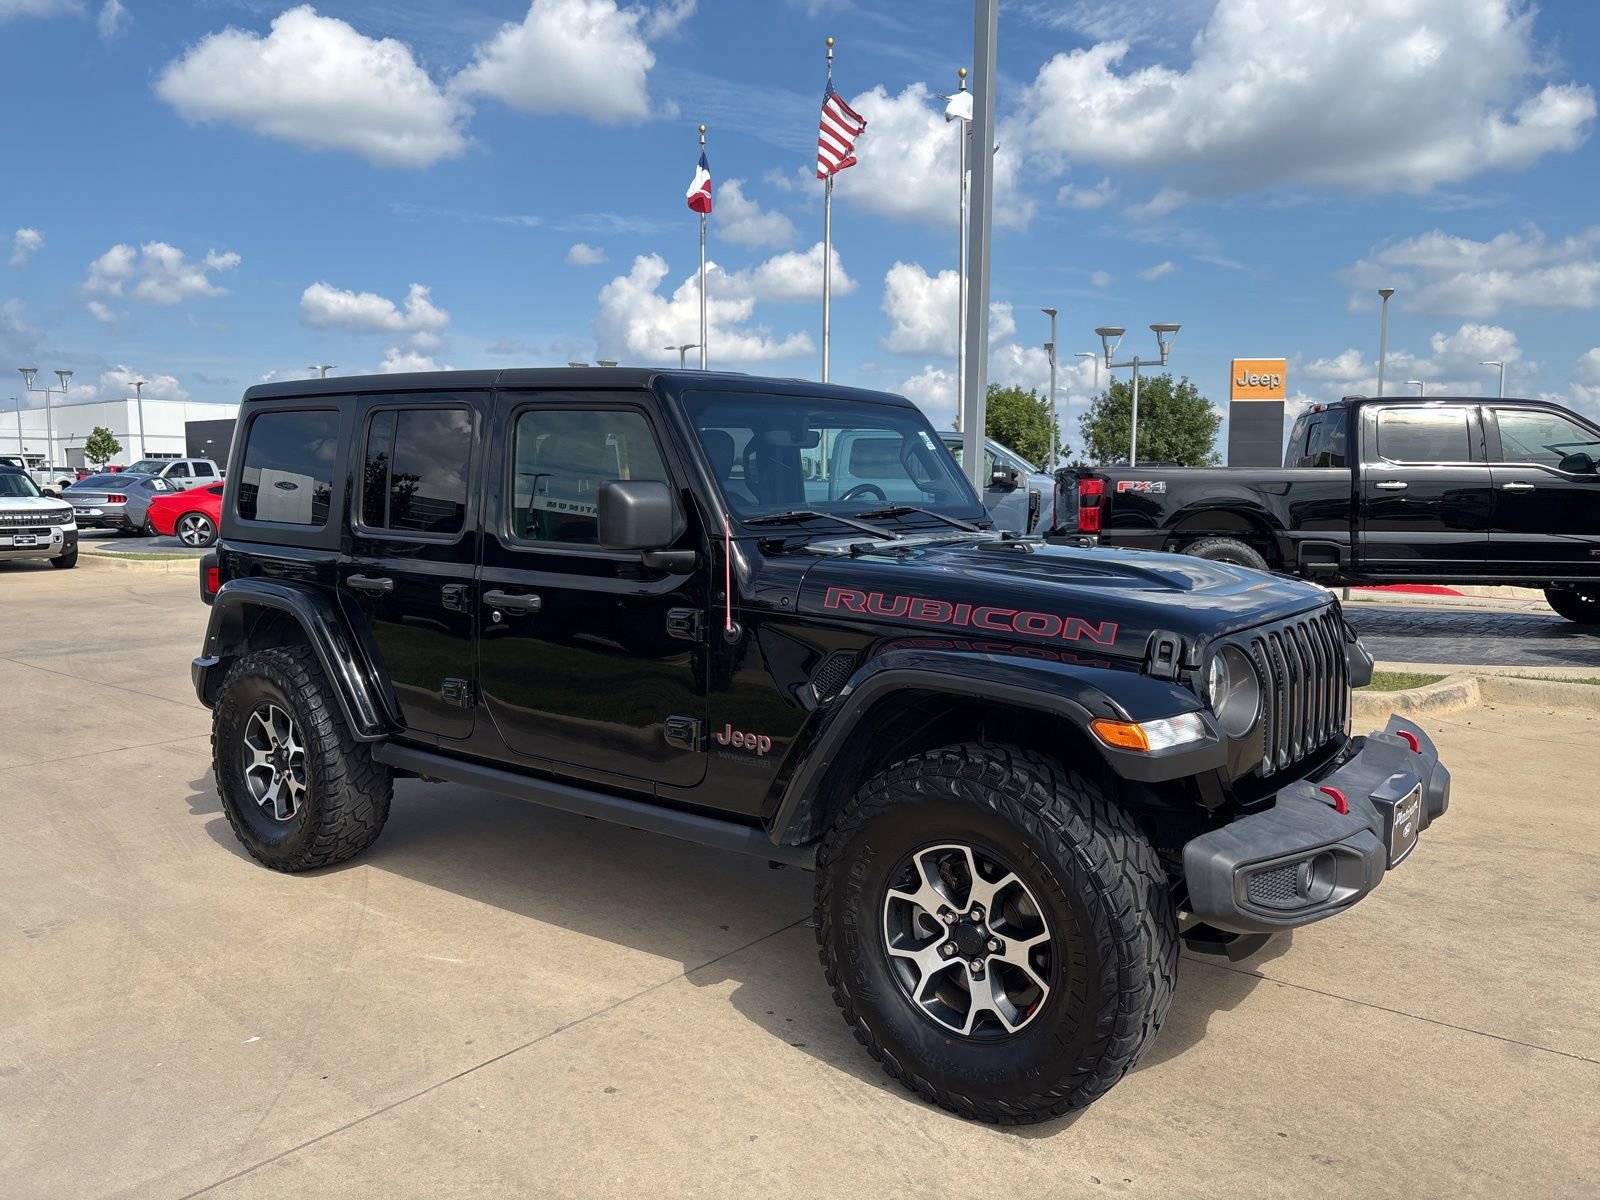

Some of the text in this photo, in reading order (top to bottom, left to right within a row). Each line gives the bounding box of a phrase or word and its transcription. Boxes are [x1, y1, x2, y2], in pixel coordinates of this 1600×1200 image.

[1236, 370, 1281, 390] Jeep
[1117, 480, 1167, 493] FX4
[823, 585, 1119, 647] RUBICON
[716, 723, 772, 756] Jeep
